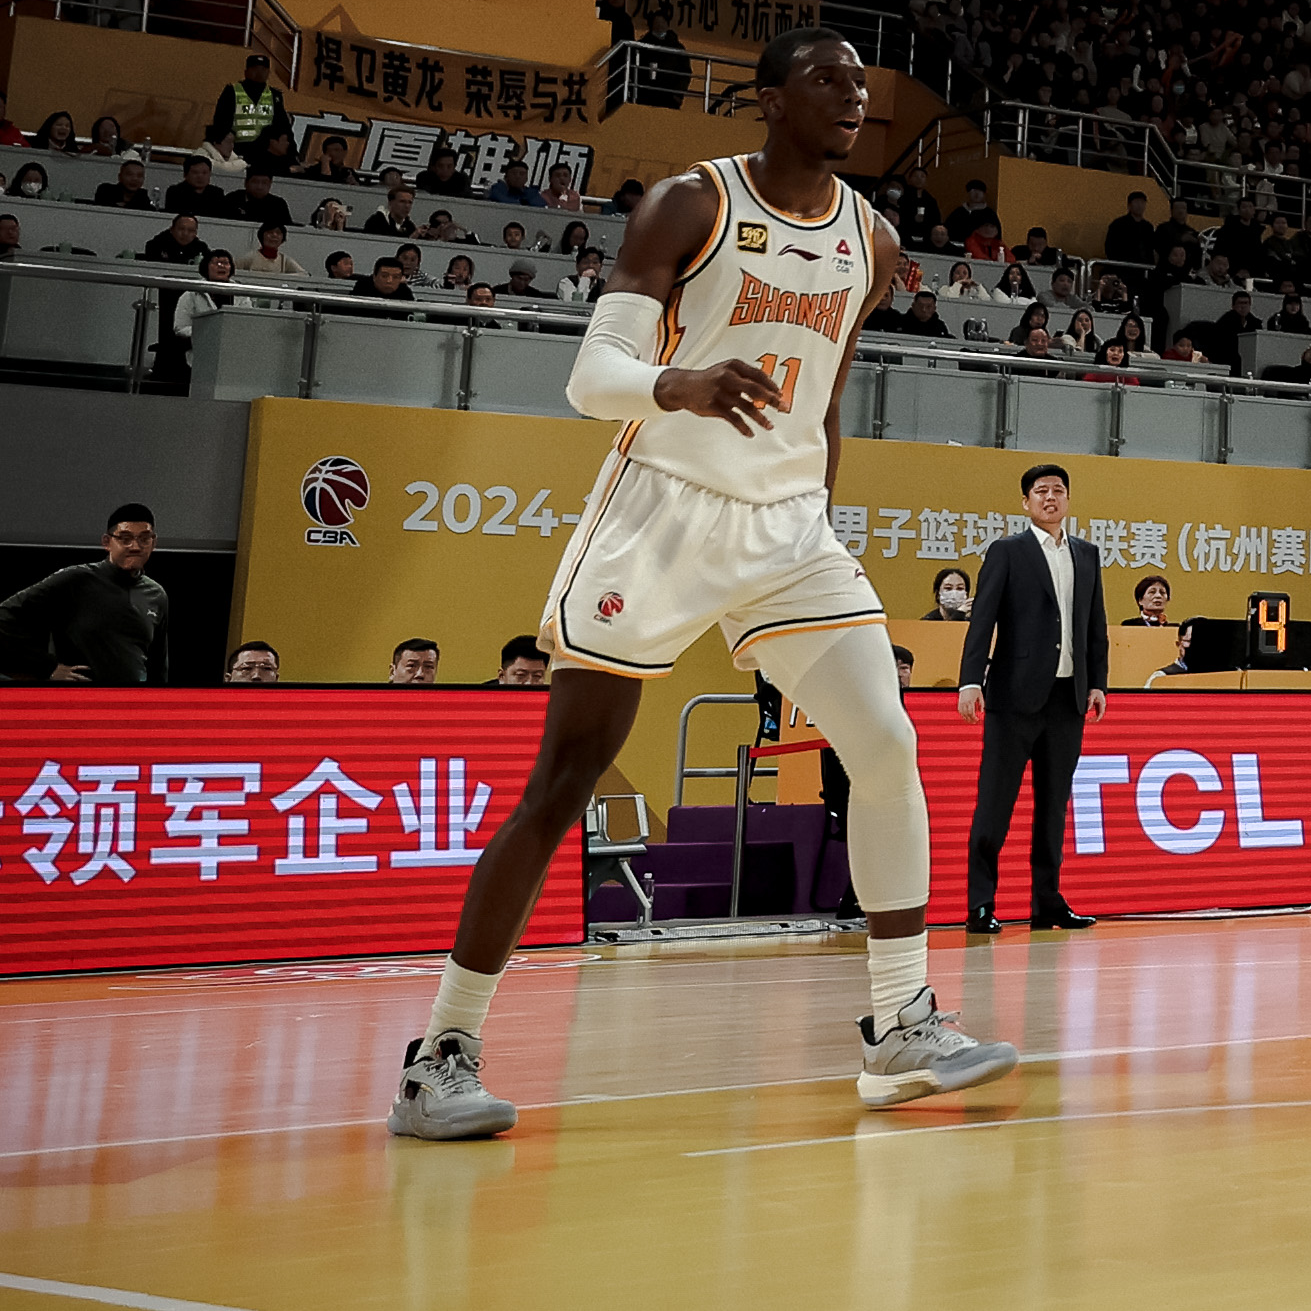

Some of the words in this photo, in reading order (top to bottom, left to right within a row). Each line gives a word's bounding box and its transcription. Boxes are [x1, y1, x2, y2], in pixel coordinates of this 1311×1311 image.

[465, 64, 589, 123] 荣辱与共
[730, 267, 853, 344] SHANXI
[402, 481, 592, 537] 2024-
[1258, 598, 1286, 653] 4
[0, 757, 492, 886] 领军企业
[1072, 748, 1304, 855] TCL
